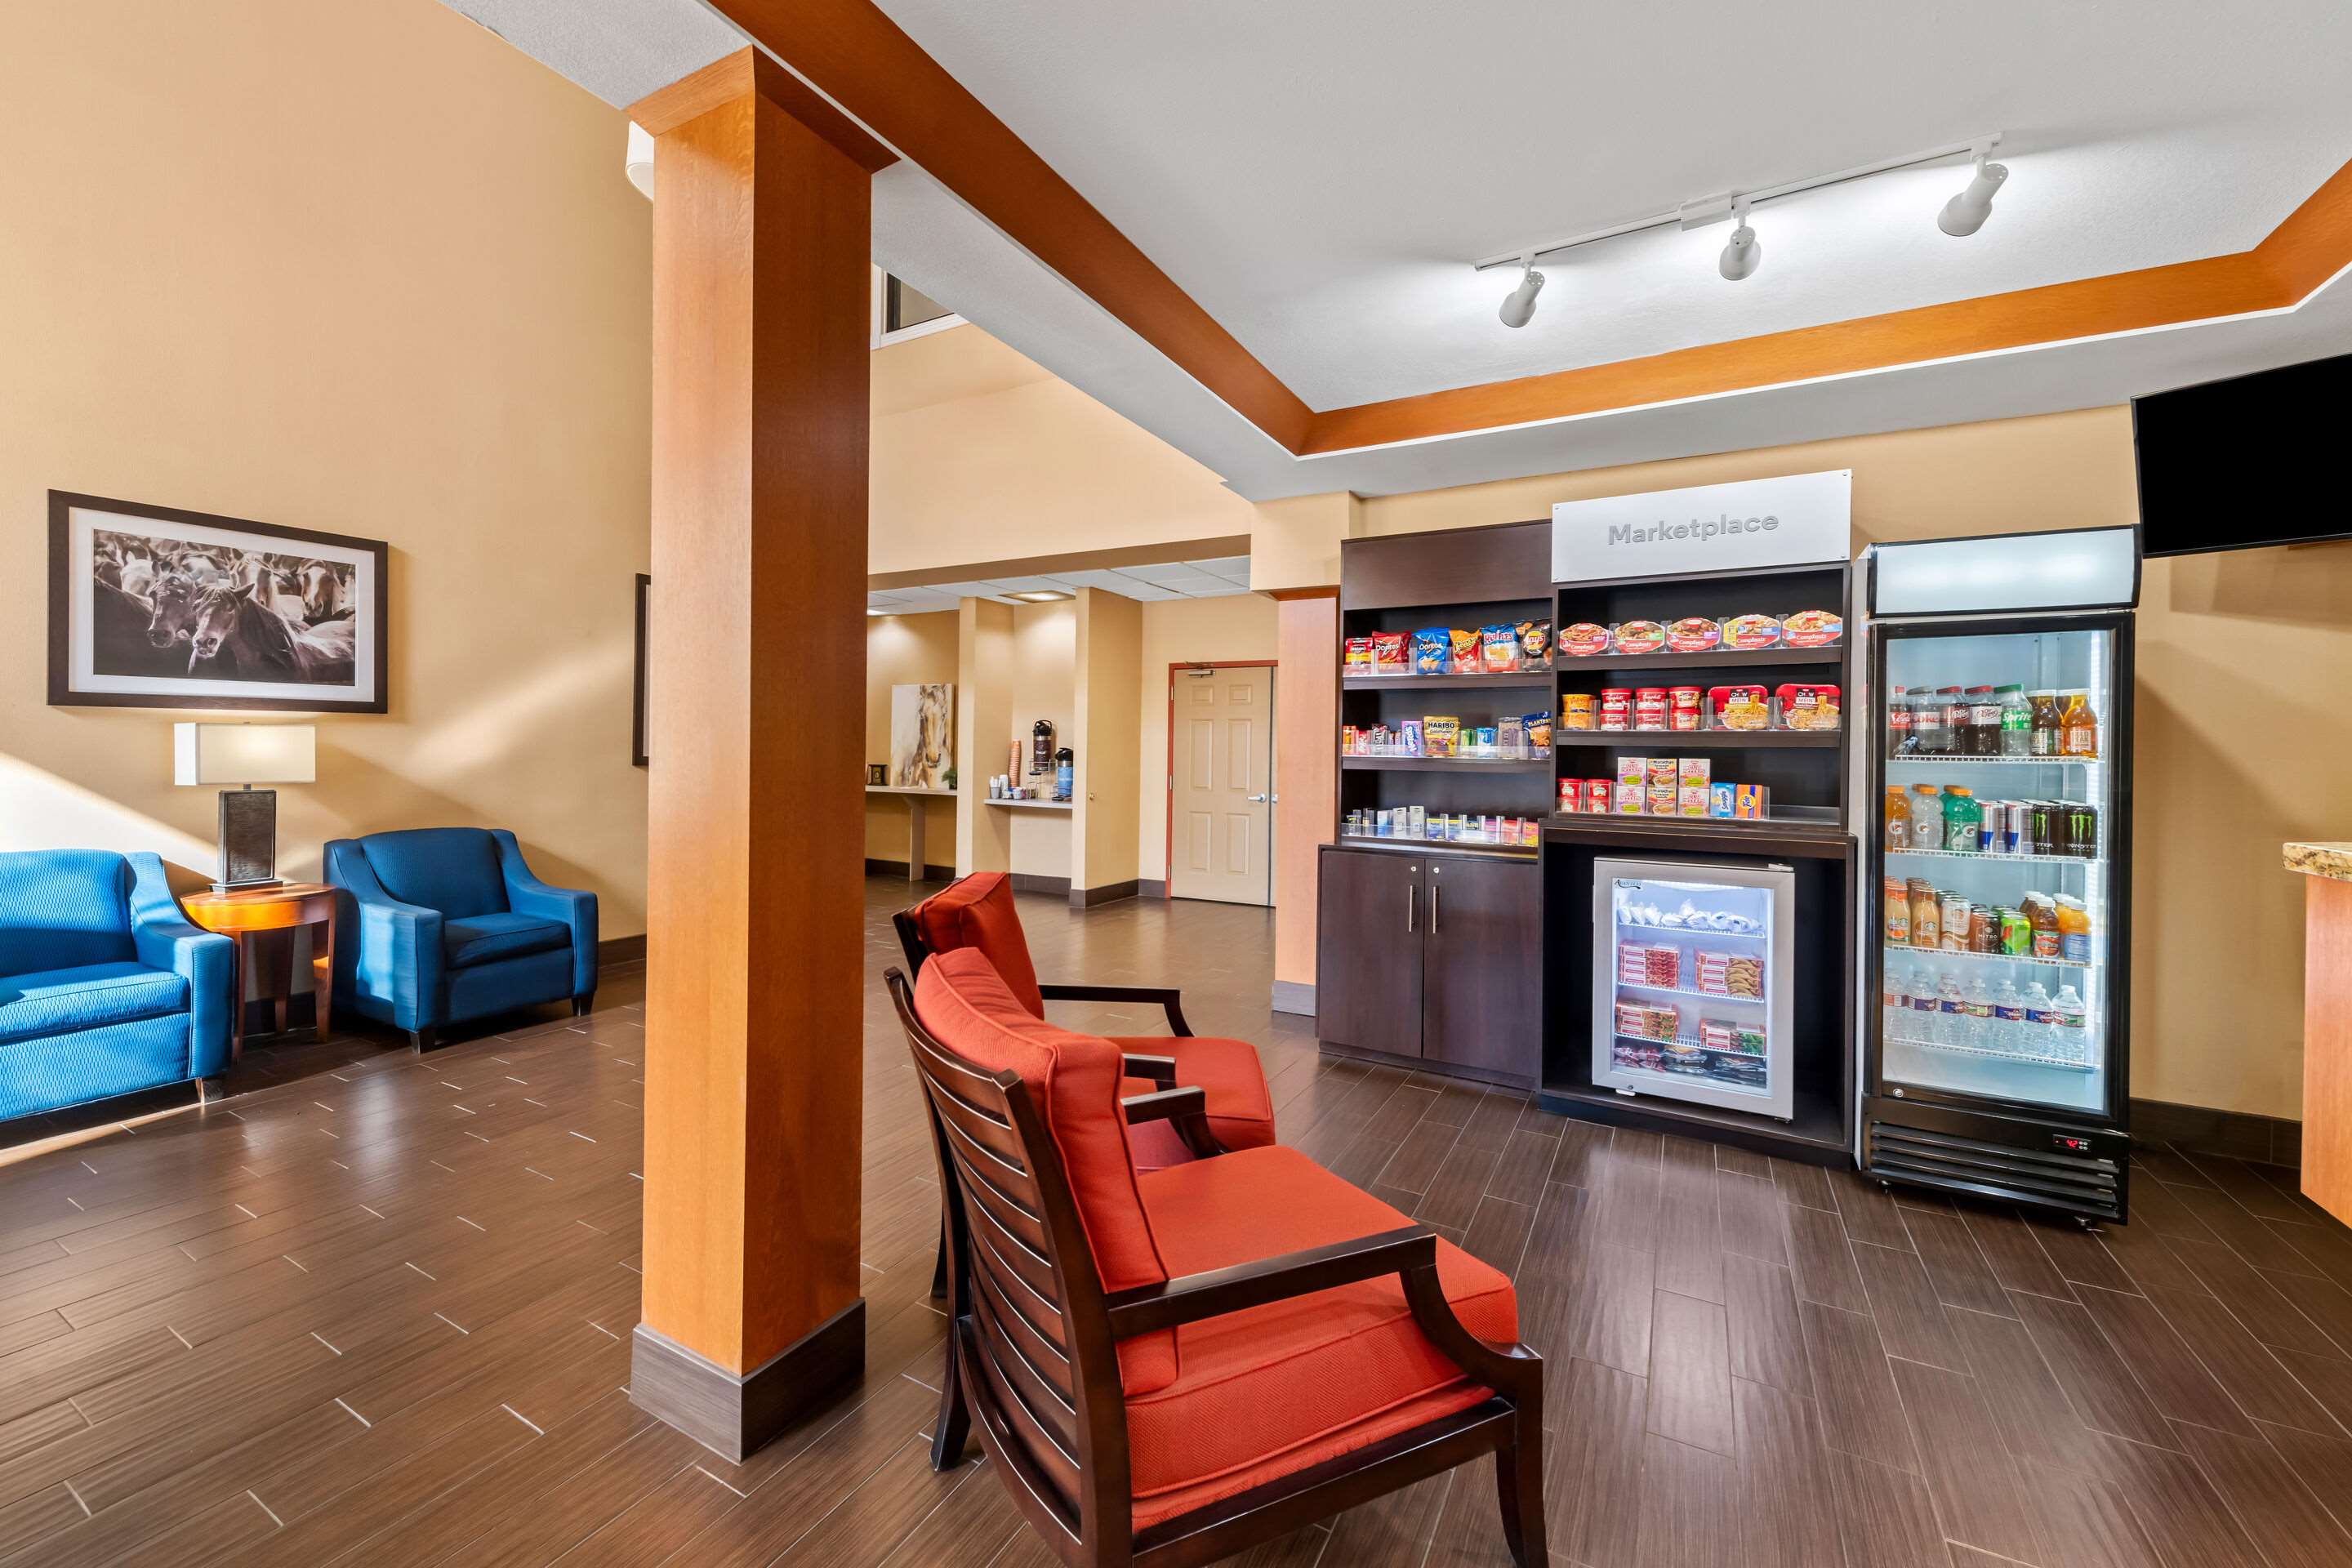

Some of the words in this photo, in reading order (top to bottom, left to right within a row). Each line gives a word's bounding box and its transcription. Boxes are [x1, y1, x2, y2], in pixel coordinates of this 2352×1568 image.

[1608, 514, 1779, 545] Marketplace
[1375, 643, 1400, 653] Doritos
[1419, 642, 1443, 653] Doritos
[2002, 711, 2032, 722] Sprite
[2066, 1139, 2078, 1148] 42
